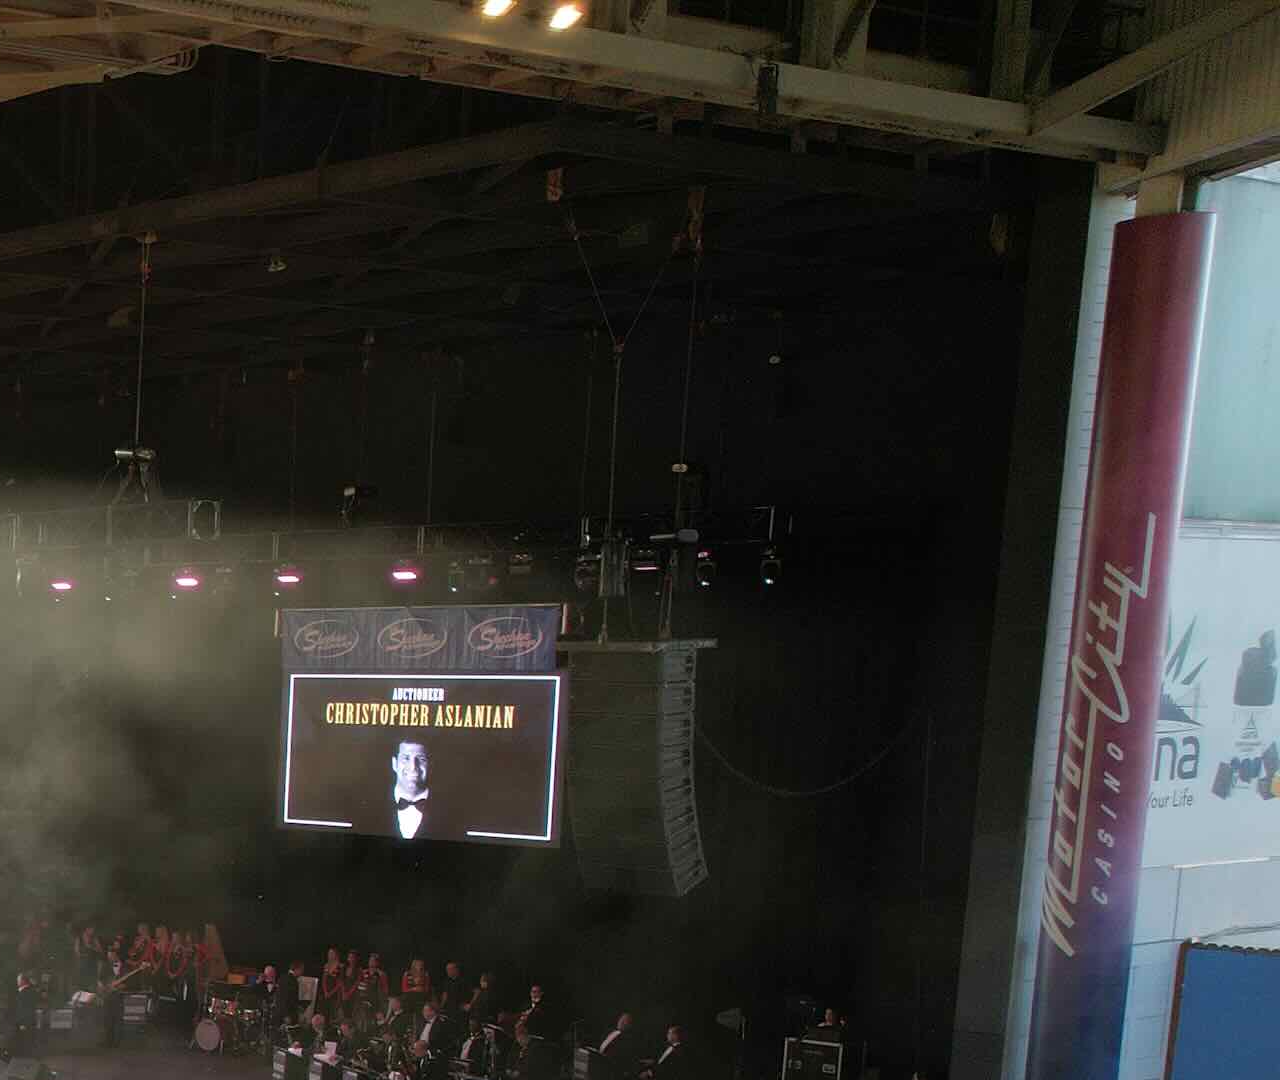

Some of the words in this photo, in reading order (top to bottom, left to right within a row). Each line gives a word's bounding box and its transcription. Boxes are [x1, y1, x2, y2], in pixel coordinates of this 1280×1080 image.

[392, 687, 445, 701] AUCTIONEER
[326, 703, 429, 727] CHRISTOPHER
[434, 704, 515, 729] ASLANIAN
[1154, 736, 1200, 781] na
[1172, 788, 1193, 807] Life
